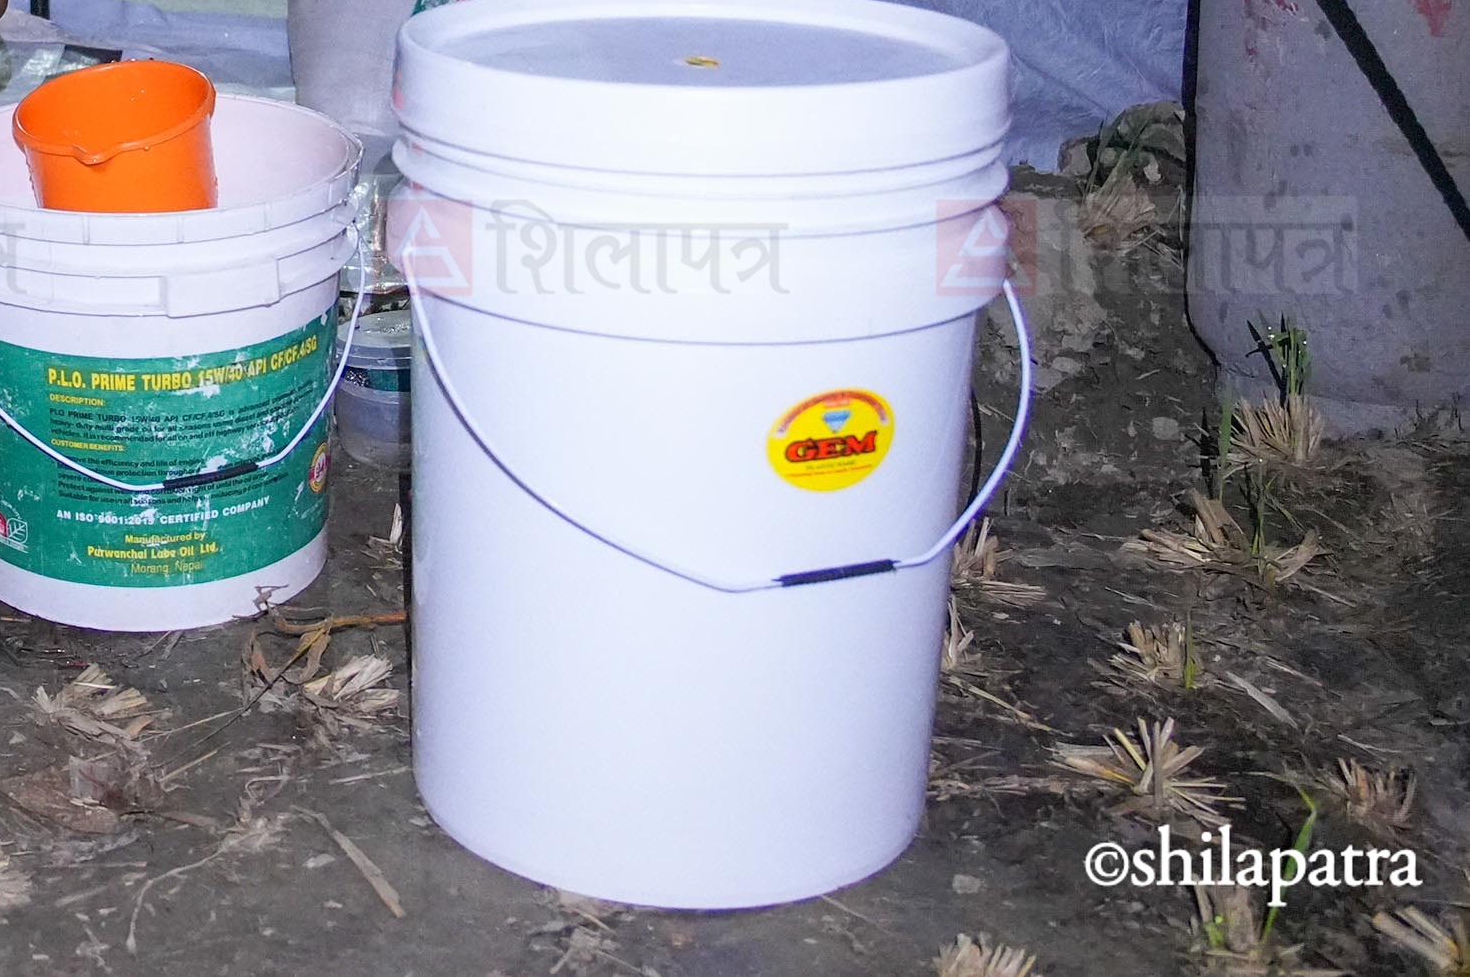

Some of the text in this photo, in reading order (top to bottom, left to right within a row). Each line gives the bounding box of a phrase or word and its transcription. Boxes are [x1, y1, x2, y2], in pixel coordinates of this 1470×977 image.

[48, 368, 86, 388] P.L.O.
[91, 373, 136, 391] PRIME
[142, 371, 192, 392] TURBO
[248, 358, 268, 377] API
[68, 411, 94, 420] PRIME
[96, 414, 126, 423] TURBO
[164, 414, 178, 422] API
[784, 429, 878, 463] GEM
[56, 510, 71, 520] AN
[75, 512, 94, 522] ISO
[160, 510, 219, 524] CERTIFIED
[222, 495, 270, 517] COMPANY
[124, 532, 192, 544] Manufactured
[179, 546, 194, 557] Oil
[200, 542, 219, 554] Ltd.
[174, 560, 204, 572] Nepal
